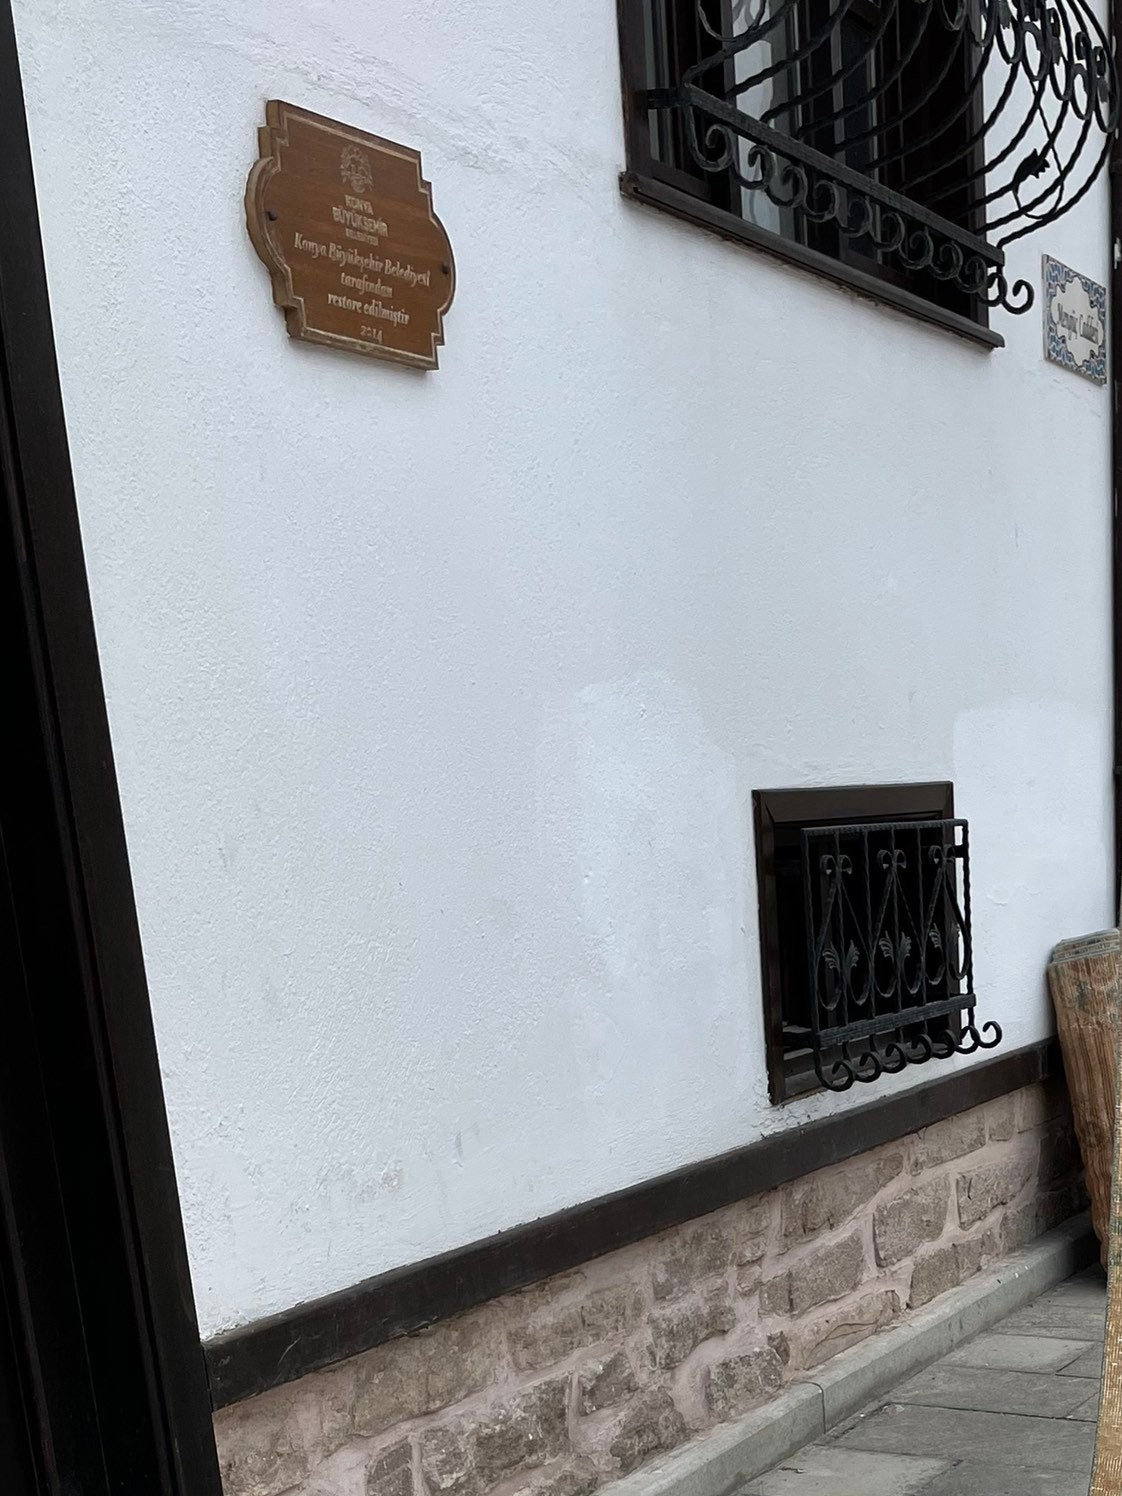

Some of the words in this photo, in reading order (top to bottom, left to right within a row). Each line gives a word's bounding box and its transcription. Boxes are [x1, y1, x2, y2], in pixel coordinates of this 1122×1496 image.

[294, 231, 328, 259] Konya
[328, 242, 384, 273] Büyükşehir
[384, 258, 431, 287] Belediyesi
[327, 293, 362, 313] restore
[363, 299, 410, 327] edilmiştir
